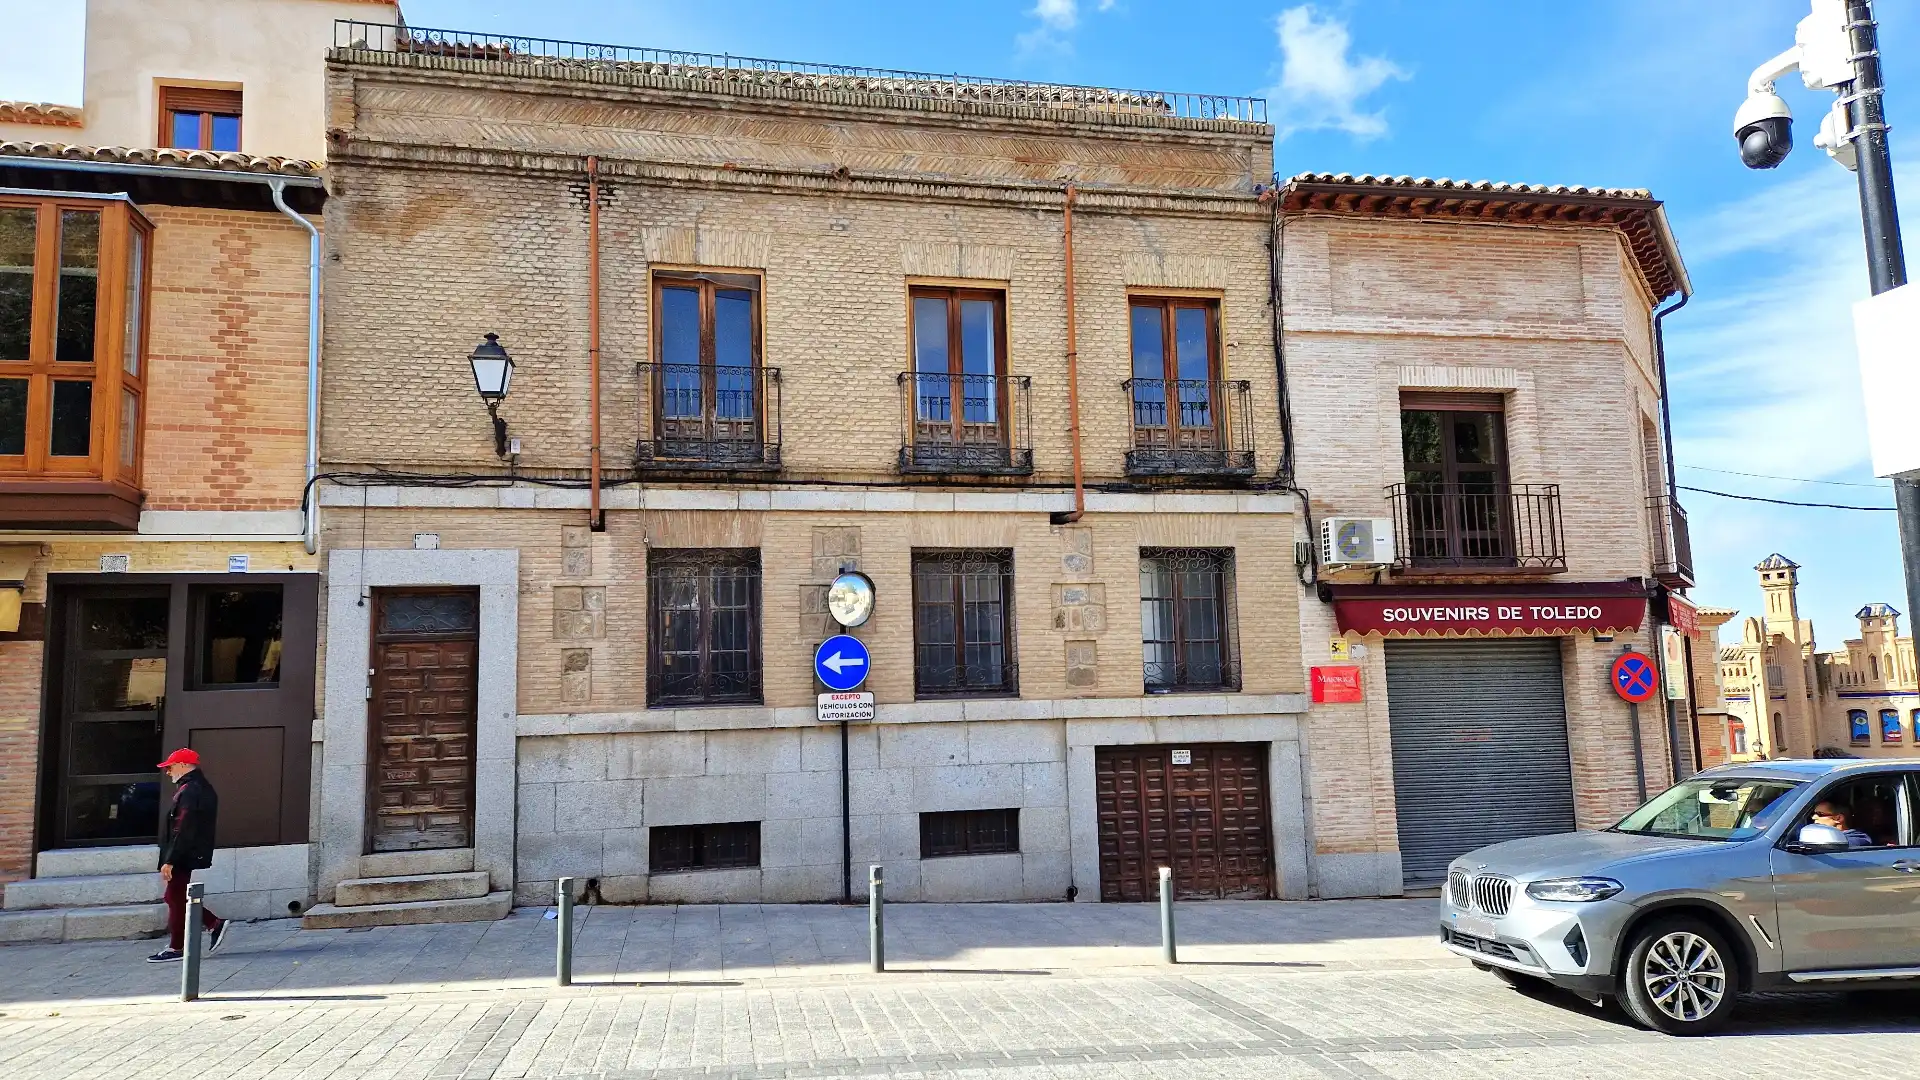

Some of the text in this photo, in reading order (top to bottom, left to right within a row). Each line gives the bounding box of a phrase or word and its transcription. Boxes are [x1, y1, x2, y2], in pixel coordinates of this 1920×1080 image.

[1383, 605, 1602, 622] SOUVENIRS DE TOLEDO
